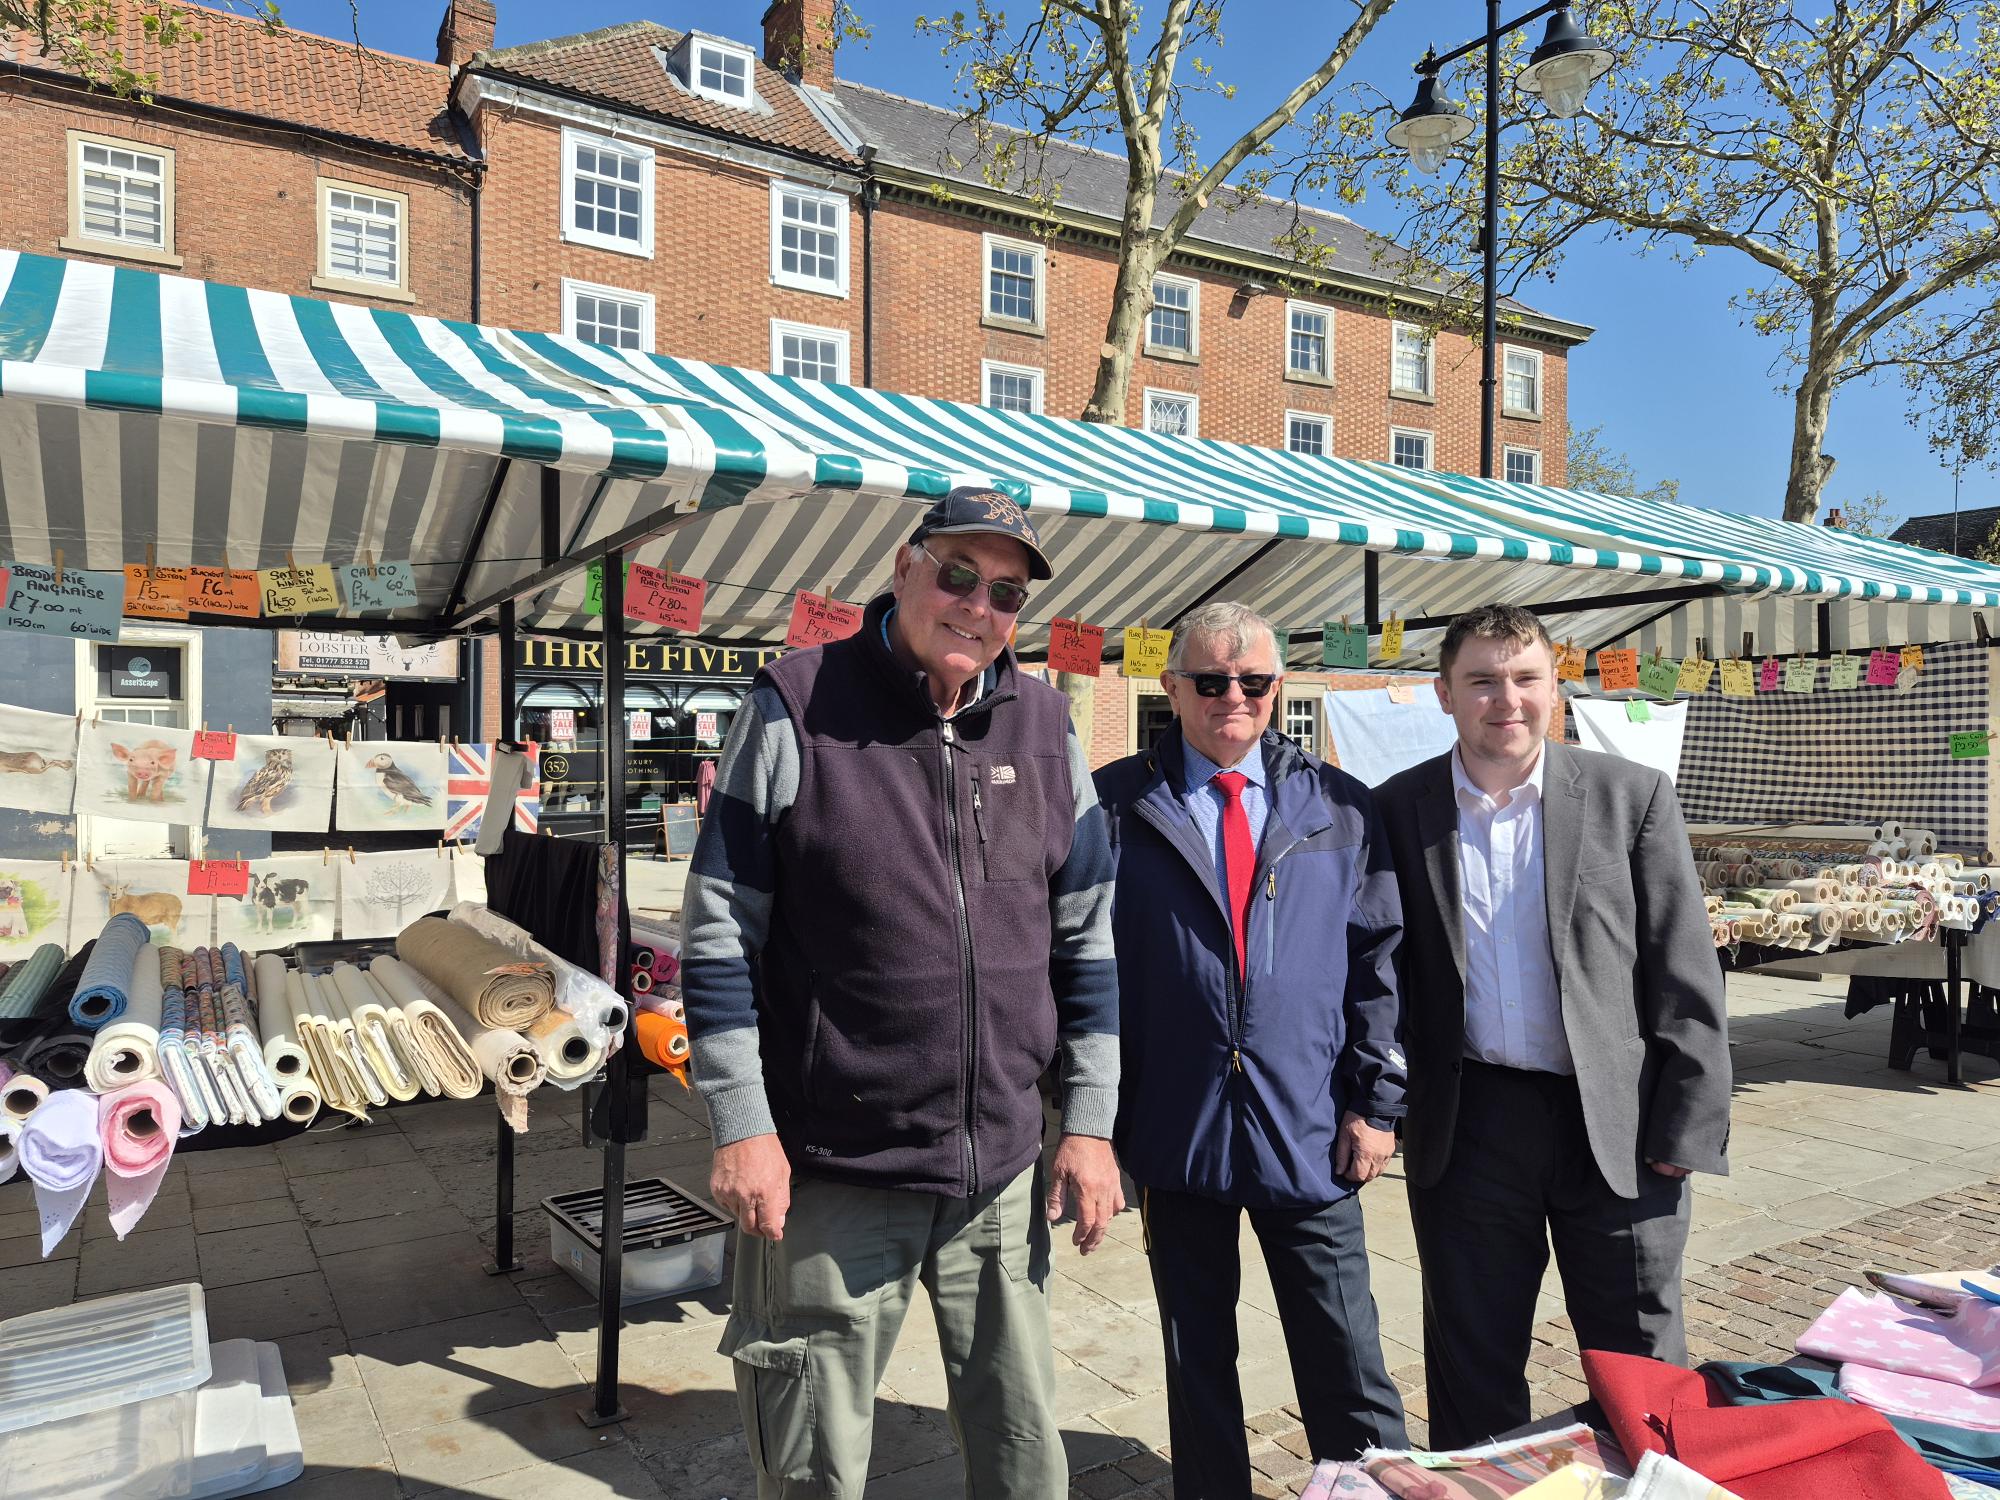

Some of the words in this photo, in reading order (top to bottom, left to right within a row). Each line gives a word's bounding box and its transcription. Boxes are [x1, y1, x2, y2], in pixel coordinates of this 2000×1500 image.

[12, 565, 85, 586] BRODRIE
[270, 568, 314, 581] SATEN
[201, 578, 223, 596] £6
[648, 590, 681, 610] £7.80
[299, 642, 369, 655] LOBSTER
[522, 640, 651, 670] THRE
[660, 645, 742, 673] FIVE
[120, 678, 159, 689] AssetScape
[552, 711, 573, 720] SALE
[632, 714, 649, 722] SALE
[697, 714, 716, 722] SALE
[552, 720, 573, 728] SALE
[697, 722, 716, 730] SALE
[552, 728, 573, 737] SALE
[546, 761, 566, 773] 352
[805, 1144, 832, 1157] KS-300
